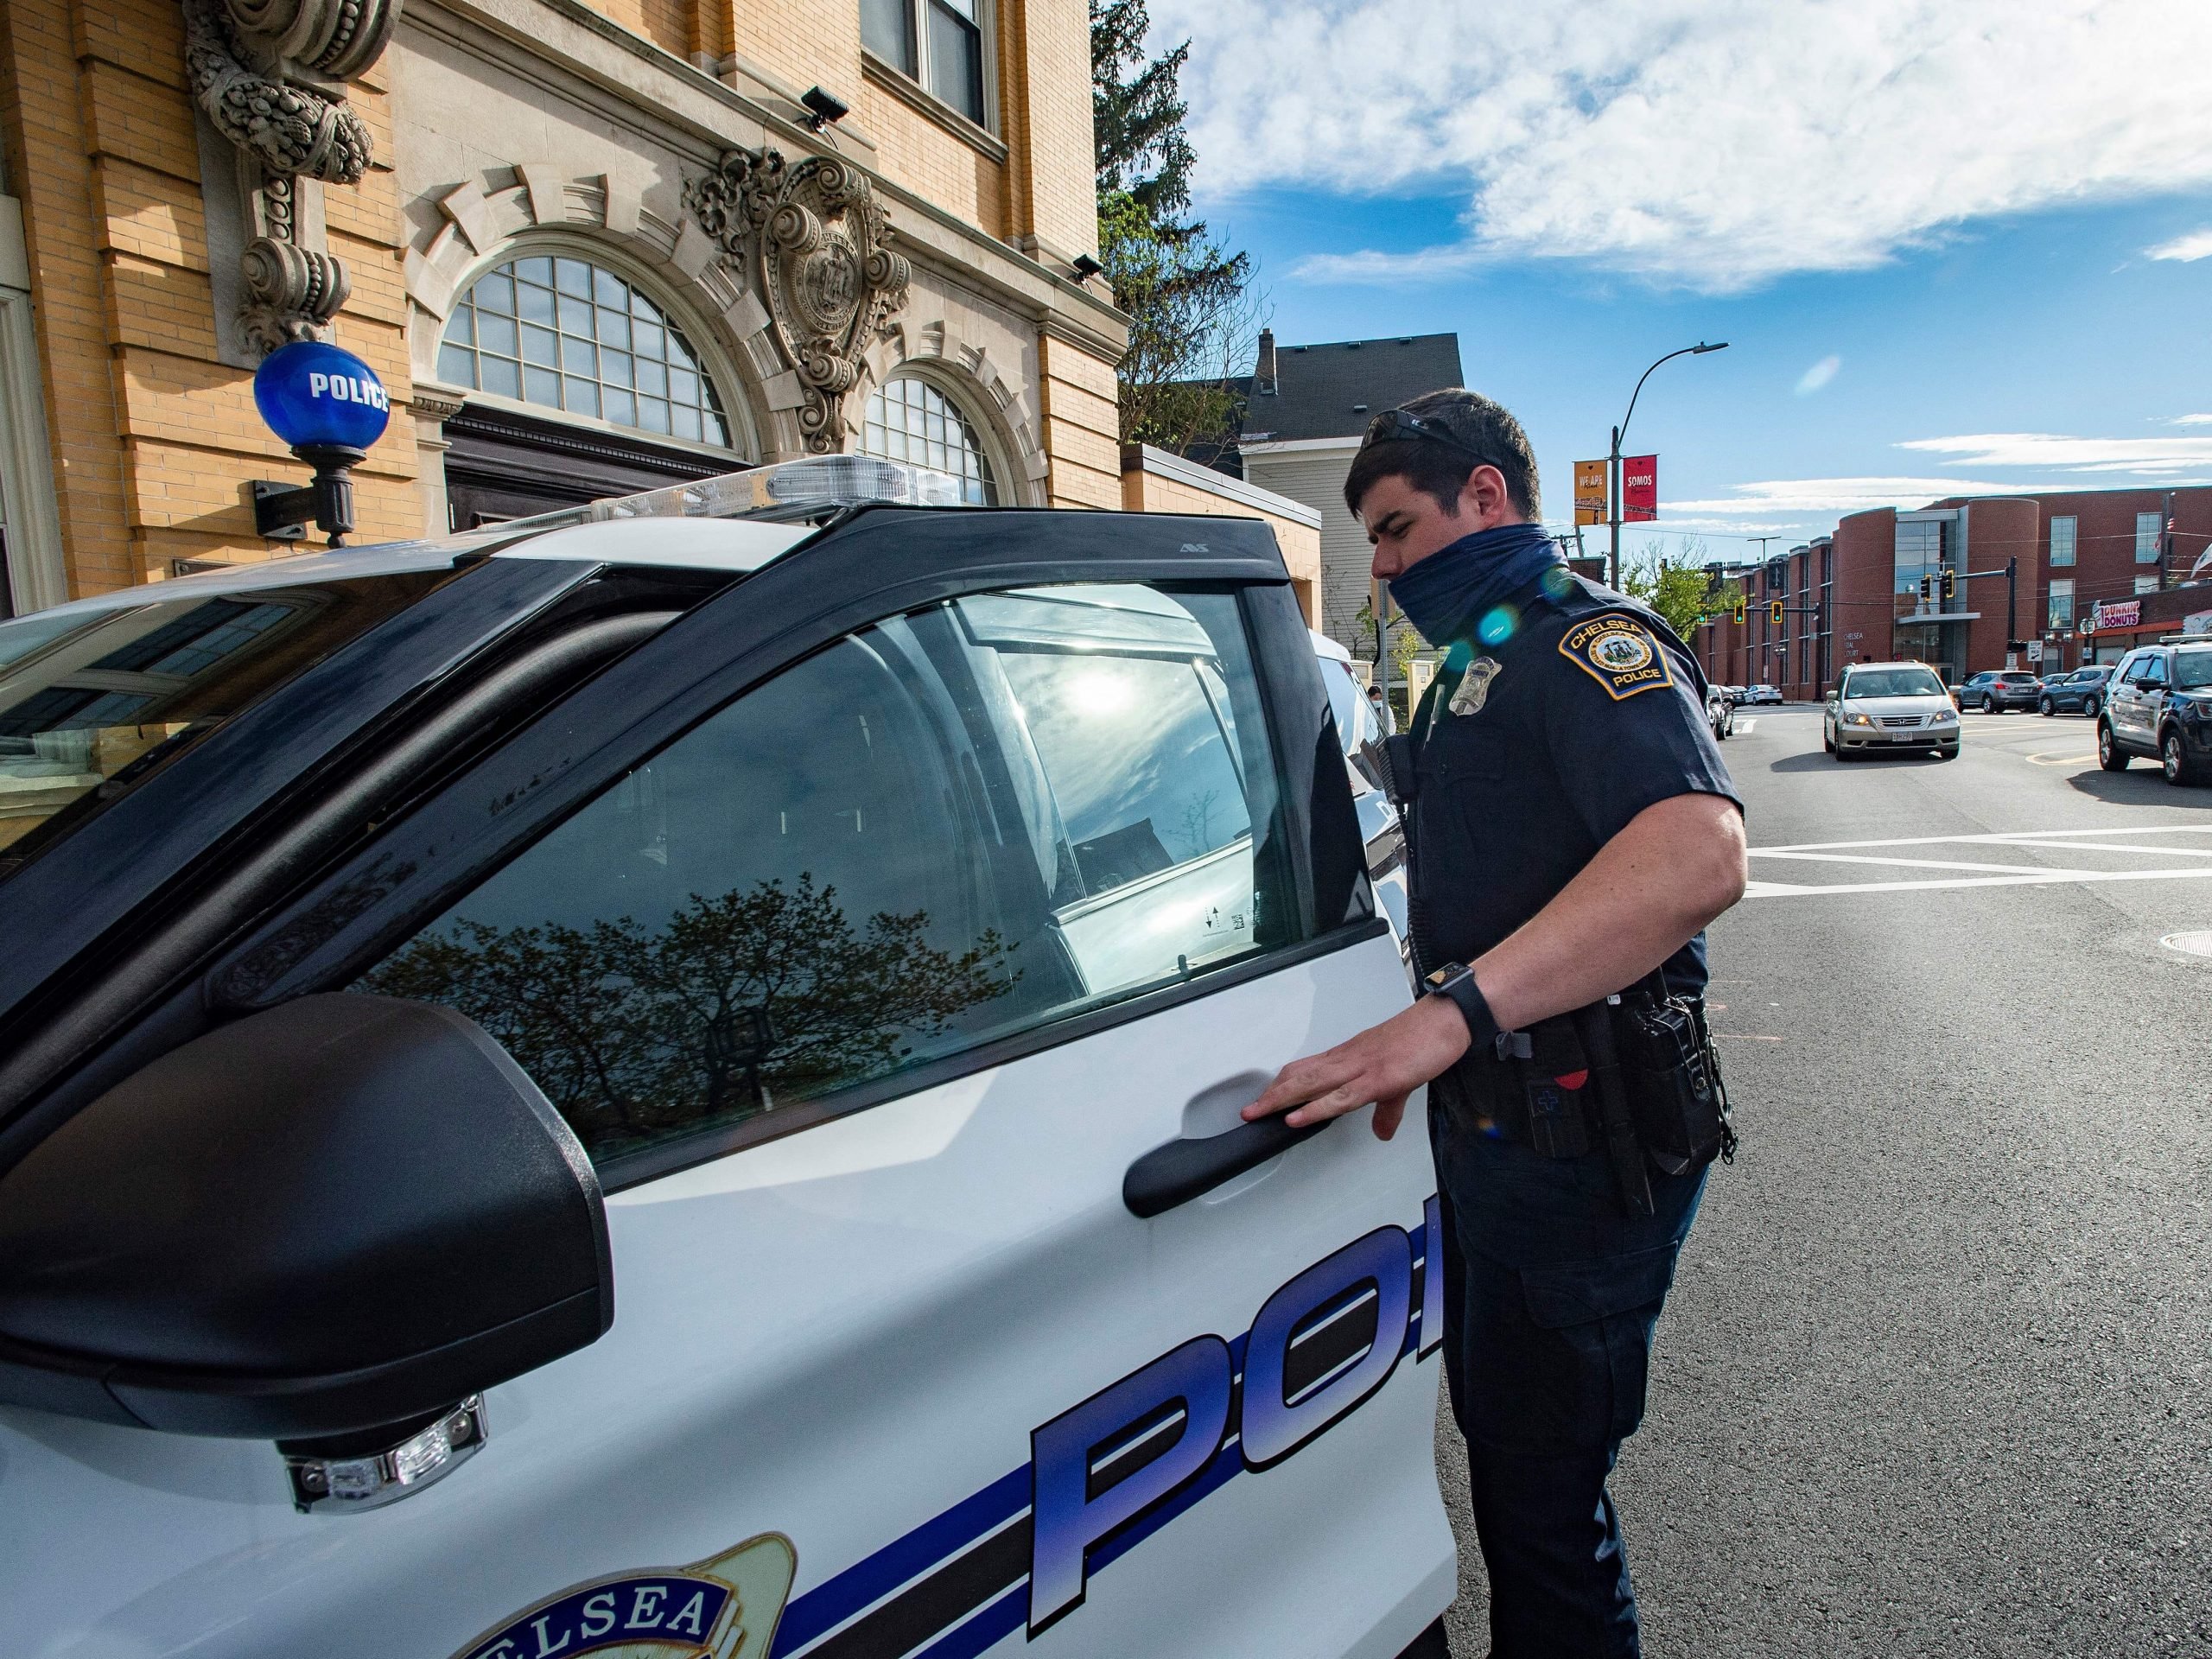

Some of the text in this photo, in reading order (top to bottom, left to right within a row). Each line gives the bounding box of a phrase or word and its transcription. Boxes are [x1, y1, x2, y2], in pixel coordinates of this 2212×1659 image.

[309, 372, 389, 413] POLICE
[1580, 474, 1603, 488] WE ARE
[1627, 474, 1652, 487] SOMOS
[2104, 601, 2139, 616] DUNKIN'
[2104, 613, 2137, 626] DONUTS
[1571, 620, 1644, 649] CHELSEA
[1613, 669, 1662, 687] POLICE
